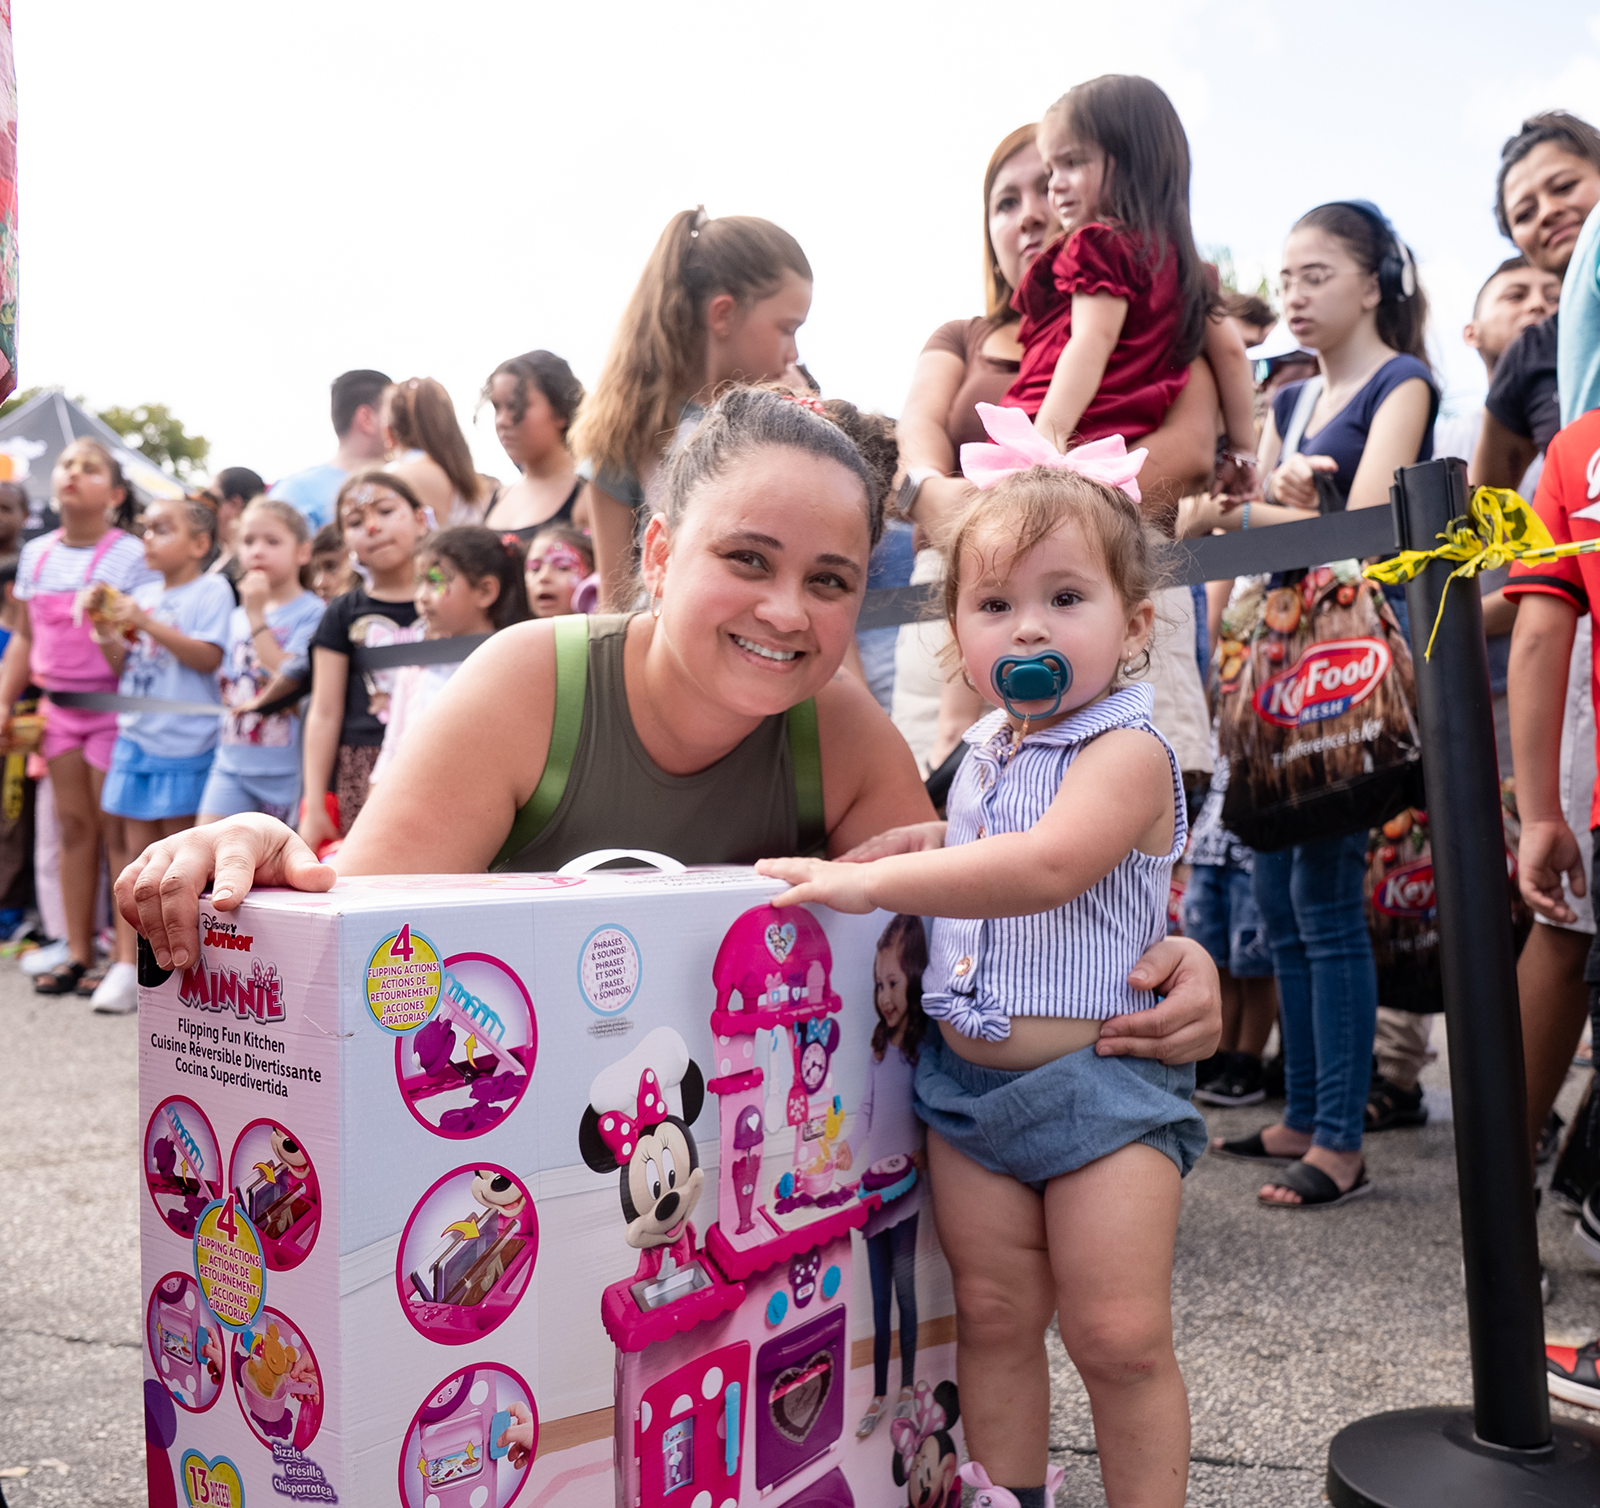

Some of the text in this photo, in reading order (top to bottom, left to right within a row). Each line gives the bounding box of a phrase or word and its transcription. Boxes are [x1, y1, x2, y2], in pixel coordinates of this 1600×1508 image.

[390, 923, 414, 962] 4
[593, 937, 623, 950] PHRASES
[597, 946, 626, 959] SOUNDS!
[367, 962, 439, 978] FLIPPING ACTIONS!
[595, 957, 624, 970] PHRASES
[381, 976, 426, 989] ACTIONS DE
[595, 972, 603, 980] ET
[599, 985, 631, 1000] SONIDOS!
[380, 1011, 428, 1026] GIRATORIAS!
[178, 1018, 285, 1054] Flipping Fun Kitchen
[151, 1033, 322, 1083] Cuisine Réversible Divertissante
[175, 1057, 288, 1097] Cocina Superdivertida
[217, 1194, 237, 1242] 4
[197, 1235, 262, 1269] FLIPPING ACTIONS!
[208, 1255, 250, 1279] ACTIONS DE
[208, 1298, 251, 1325] GIRATORIAS!
[273, 1443, 301, 1460] Sizzle
[285, 1463, 322, 1479] Grésille
[188, 1466, 210, 1503] 13
[273, 1478, 333, 1496] Chisporrotea
